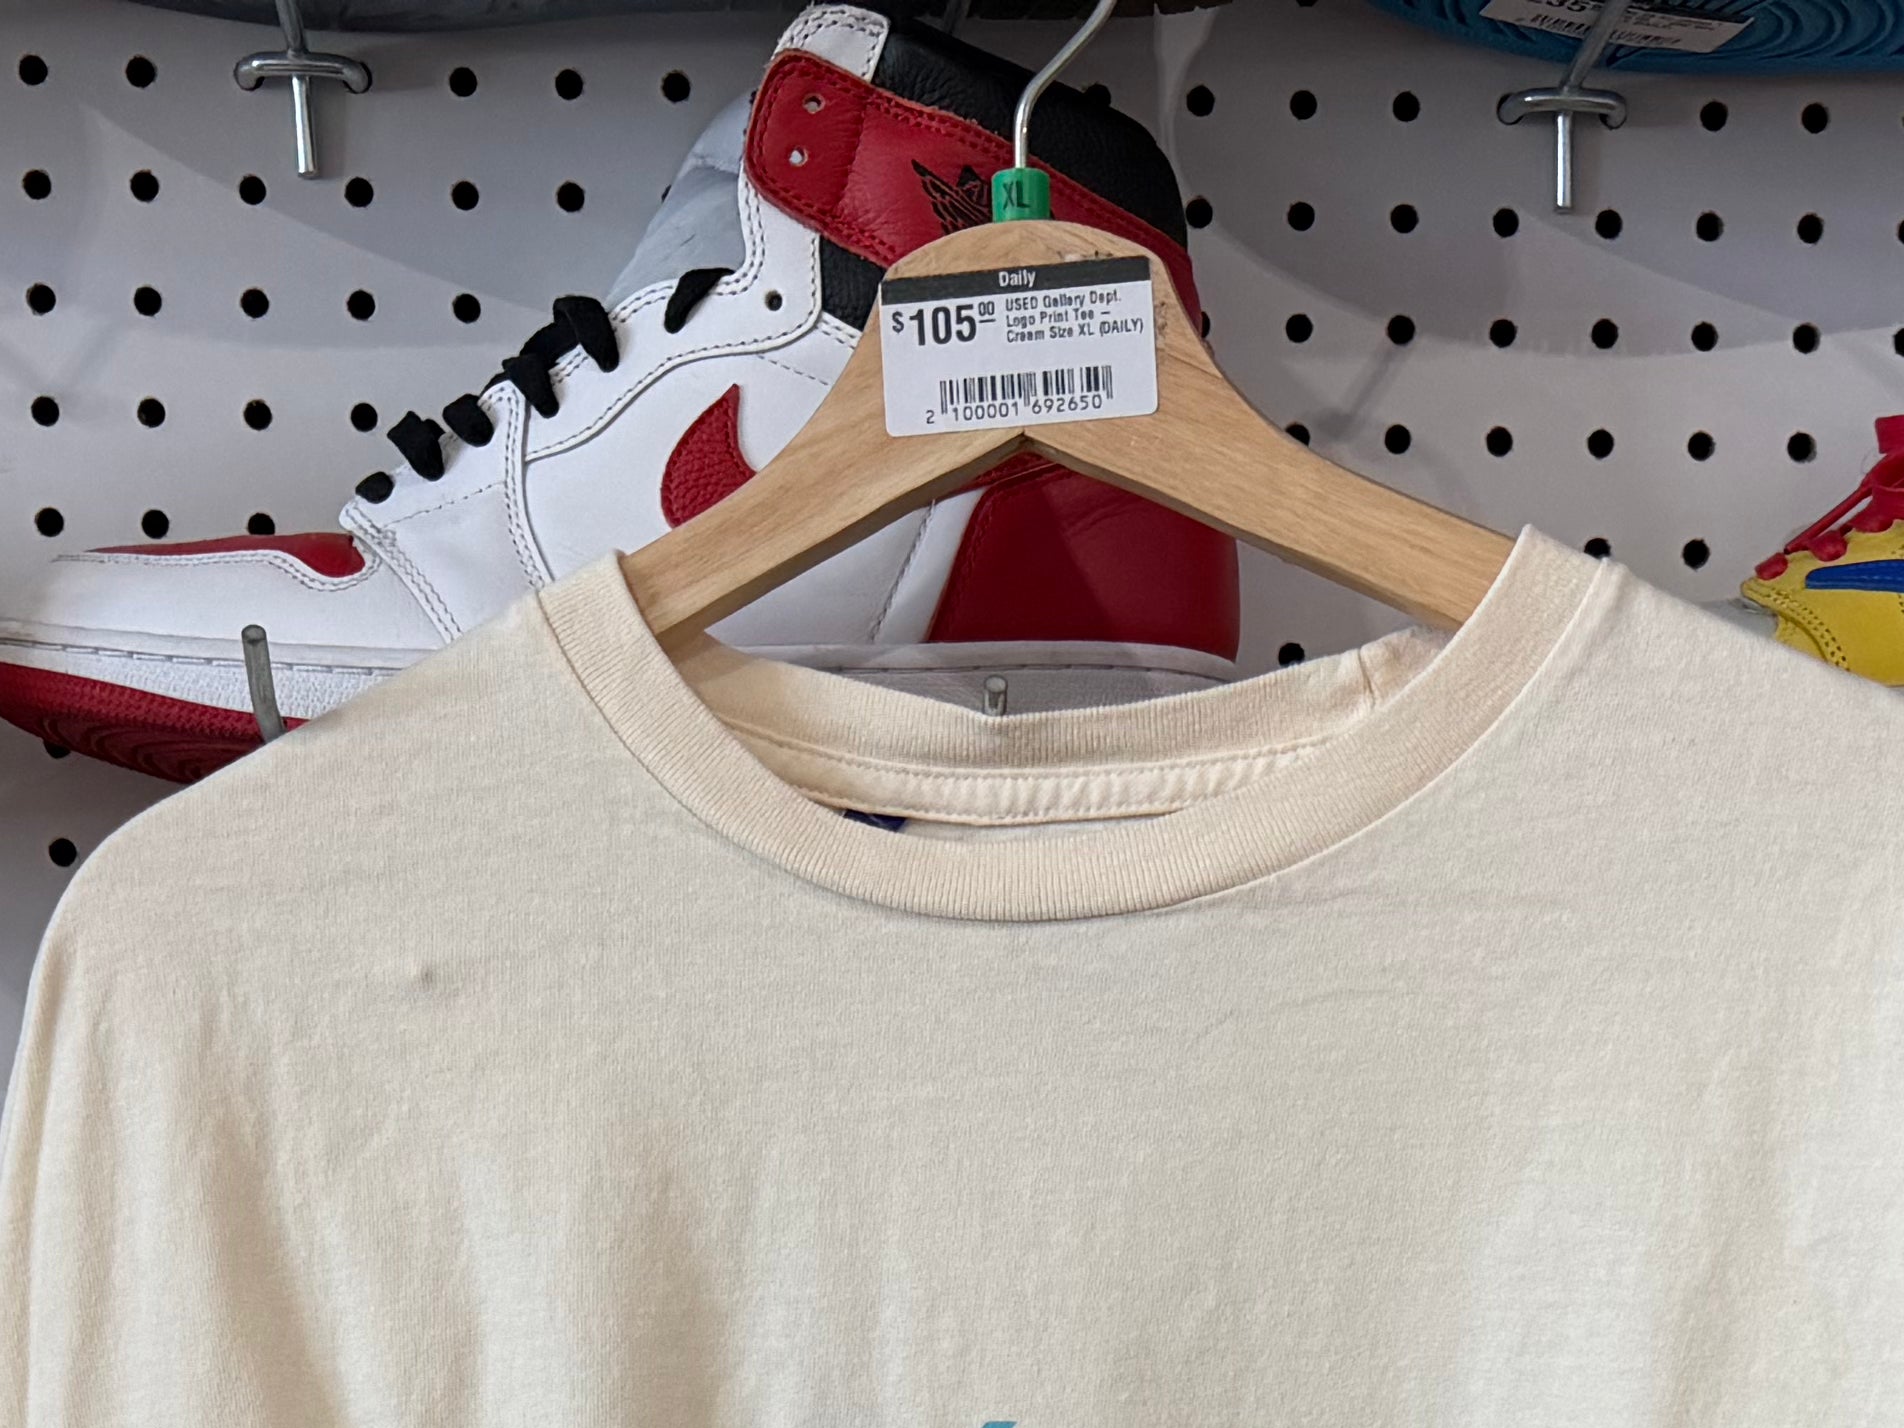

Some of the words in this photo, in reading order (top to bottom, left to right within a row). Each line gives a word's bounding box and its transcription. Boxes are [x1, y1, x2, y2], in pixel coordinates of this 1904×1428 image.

[1002, 180, 1031, 210] XL
[998, 269, 1037, 288] Daily
[1005, 296, 1039, 312] USED
[1089, 289, 1122, 306] Dept.
[1006, 314, 1036, 330] Logo
[1039, 310, 1070, 324] Print
[1073, 308, 1095, 321] Tee
[1006, 330, 1045, 343] Cream
[1049, 326, 1074, 339] Size
[1078, 323, 1095, 336] XL
[1099, 318, 1145, 337] (DAILY)
[926, 409, 936, 425] 2
[952, 401, 1021, 422] 100001
[1031, 393, 1103, 415] 692650
